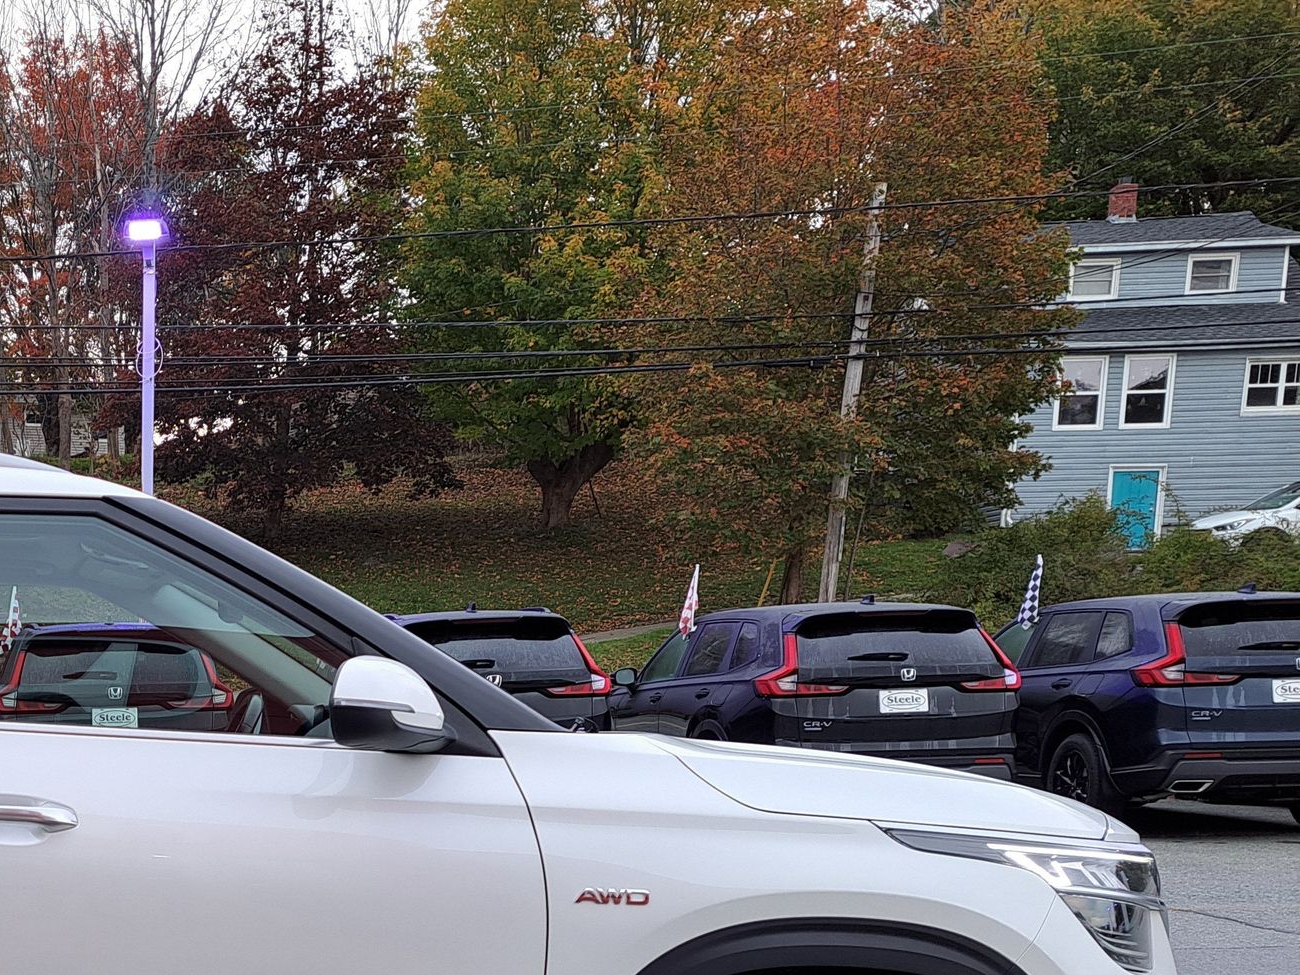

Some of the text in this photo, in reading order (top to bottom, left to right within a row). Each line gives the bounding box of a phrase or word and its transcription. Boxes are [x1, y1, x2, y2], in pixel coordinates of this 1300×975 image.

[886, 695, 922, 704] Steele
[99, 713, 131, 722] Steele
[574, 887, 652, 906] AWD
